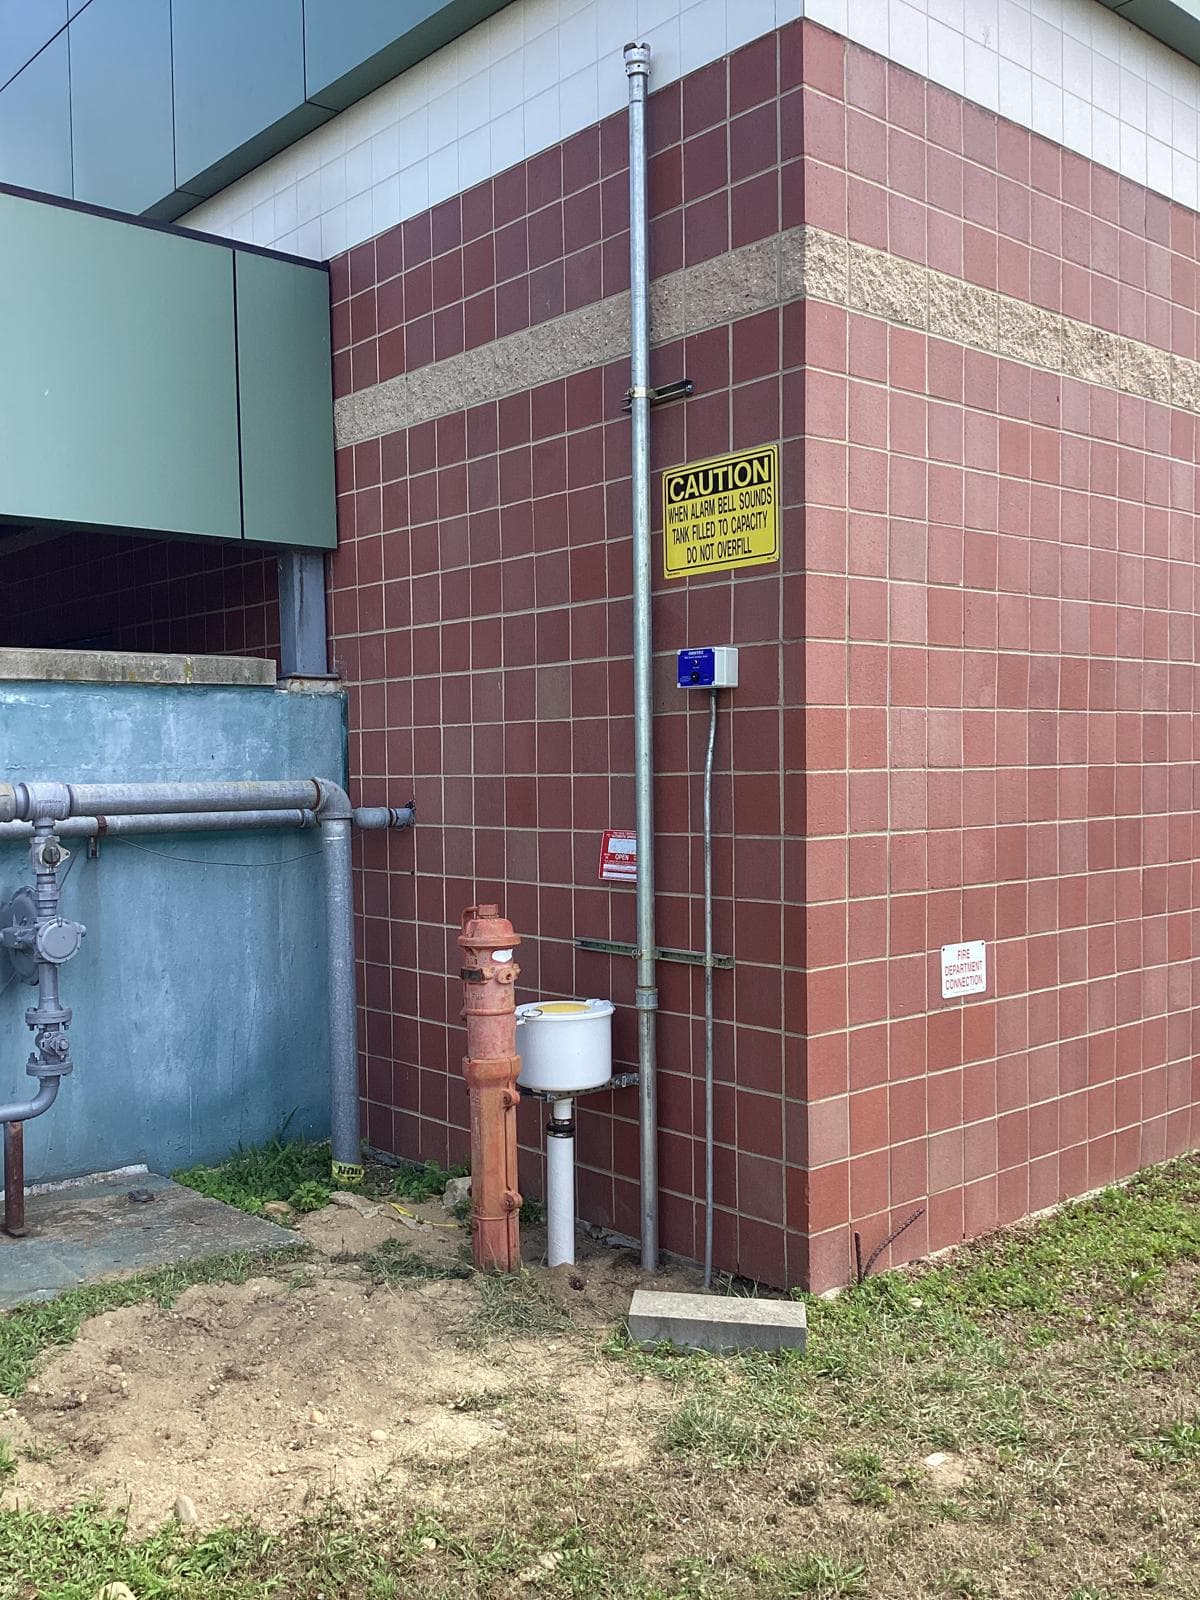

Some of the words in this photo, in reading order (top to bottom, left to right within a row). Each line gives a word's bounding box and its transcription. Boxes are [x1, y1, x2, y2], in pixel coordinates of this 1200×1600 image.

[669, 456, 769, 502] CAUTION
[668, 505, 688, 524] WHEN
[691, 499, 715, 520] ALARM
[718, 494, 736, 514] BELL
[739, 486, 772, 510] SOUNDS
[672, 526, 690, 545] TANK
[692, 521, 716, 541] FILLED
[718, 518, 728, 535] TO
[731, 510, 768, 534] CAPACITY
[687, 546, 697, 563] DO
[700, 543, 714, 561] NOT
[717, 537, 752, 558] OVERFILL
[614, 853, 629, 861] OPEN
[957, 948, 970, 960] FIRE
[945, 960, 983, 976] DEPARTMENT
[946, 974, 983, 990] CONNECTION
